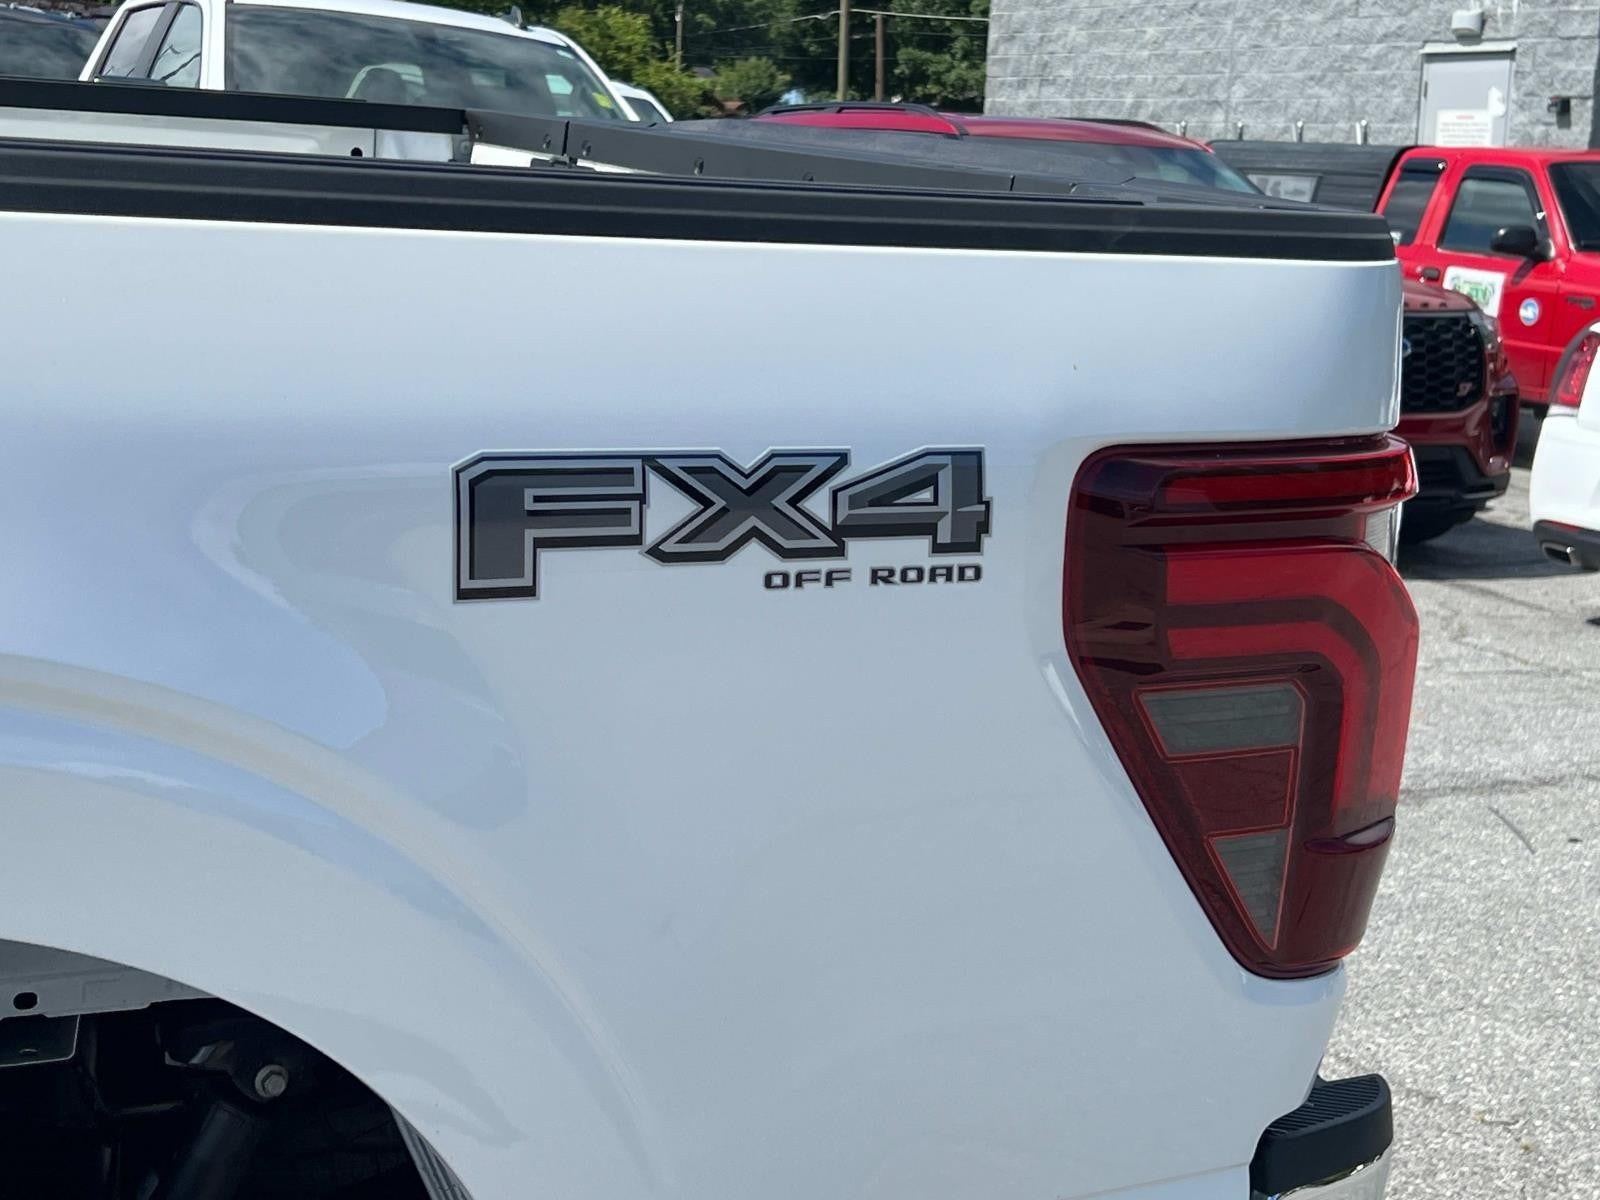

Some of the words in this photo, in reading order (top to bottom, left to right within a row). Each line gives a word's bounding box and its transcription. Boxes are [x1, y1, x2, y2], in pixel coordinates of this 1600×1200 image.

[452, 446, 992, 603] FX4
[763, 567, 852, 590] OFF
[869, 563, 983, 587] ROAD
